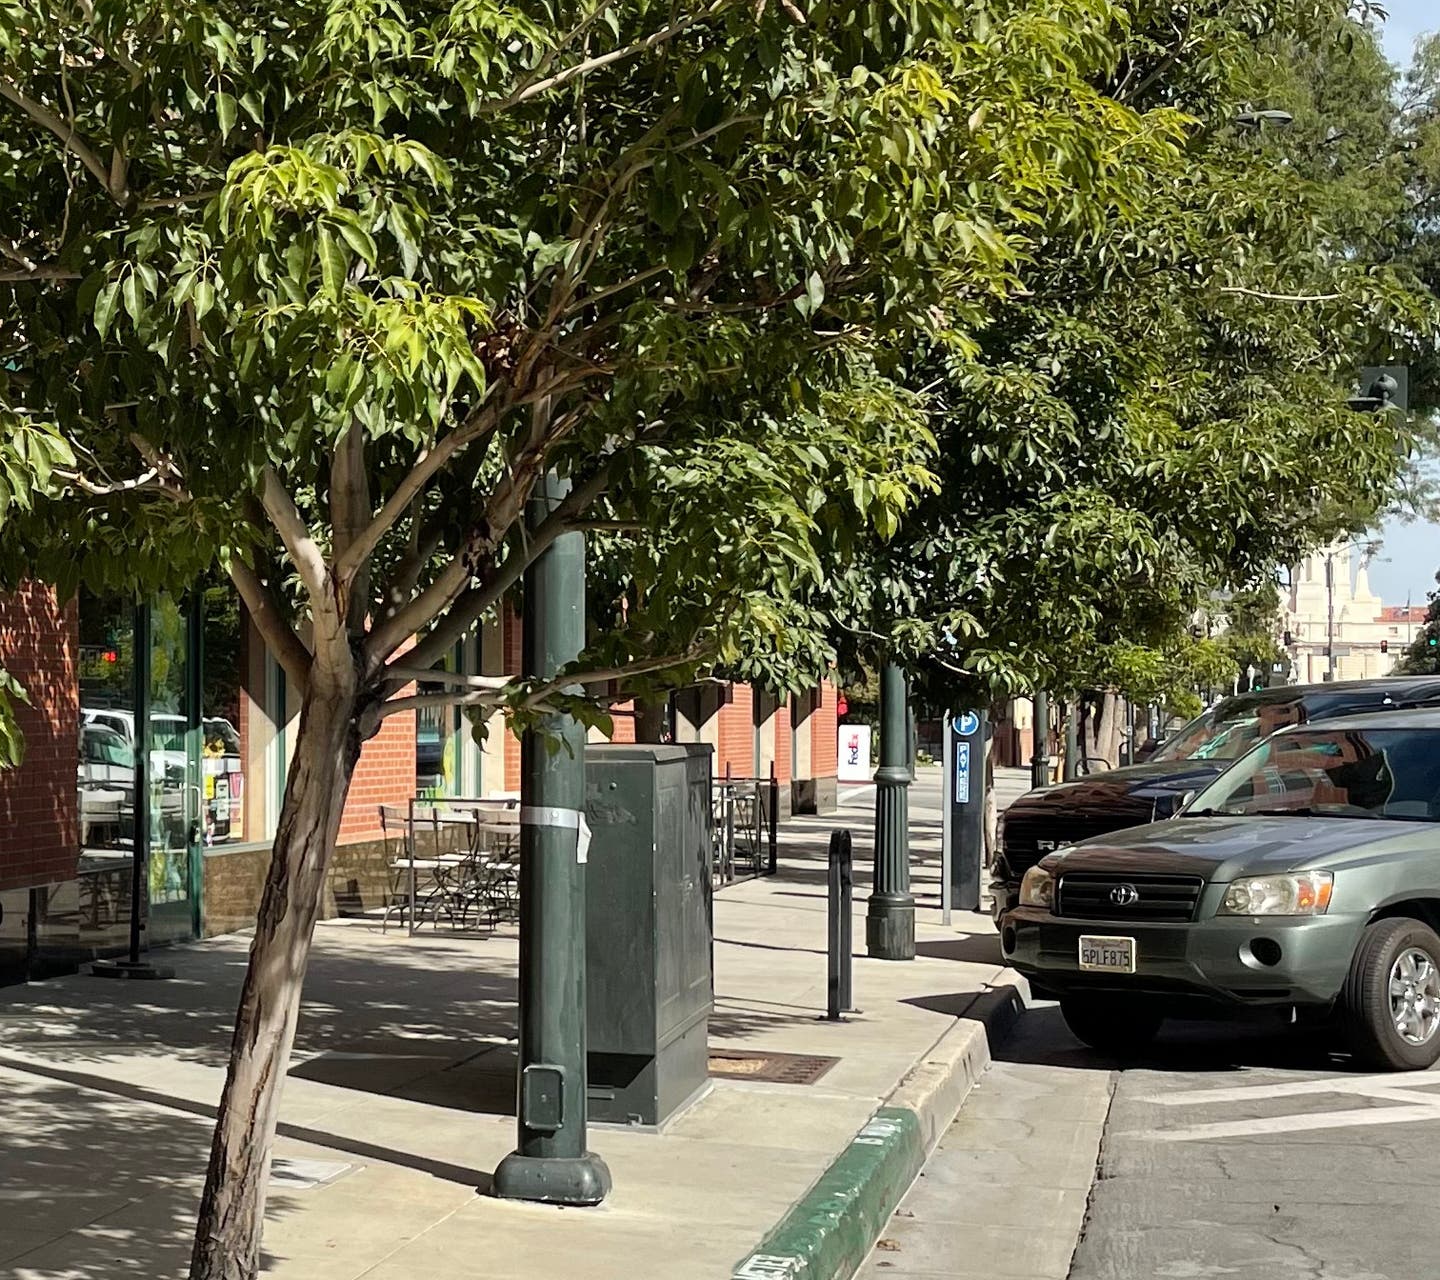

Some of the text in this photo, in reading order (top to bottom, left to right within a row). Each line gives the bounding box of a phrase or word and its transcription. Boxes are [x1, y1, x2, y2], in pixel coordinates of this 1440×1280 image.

[960, 714, 973, 732] P
[848, 734, 859, 766] FedEx
[1037, 839, 1072, 850] RA
